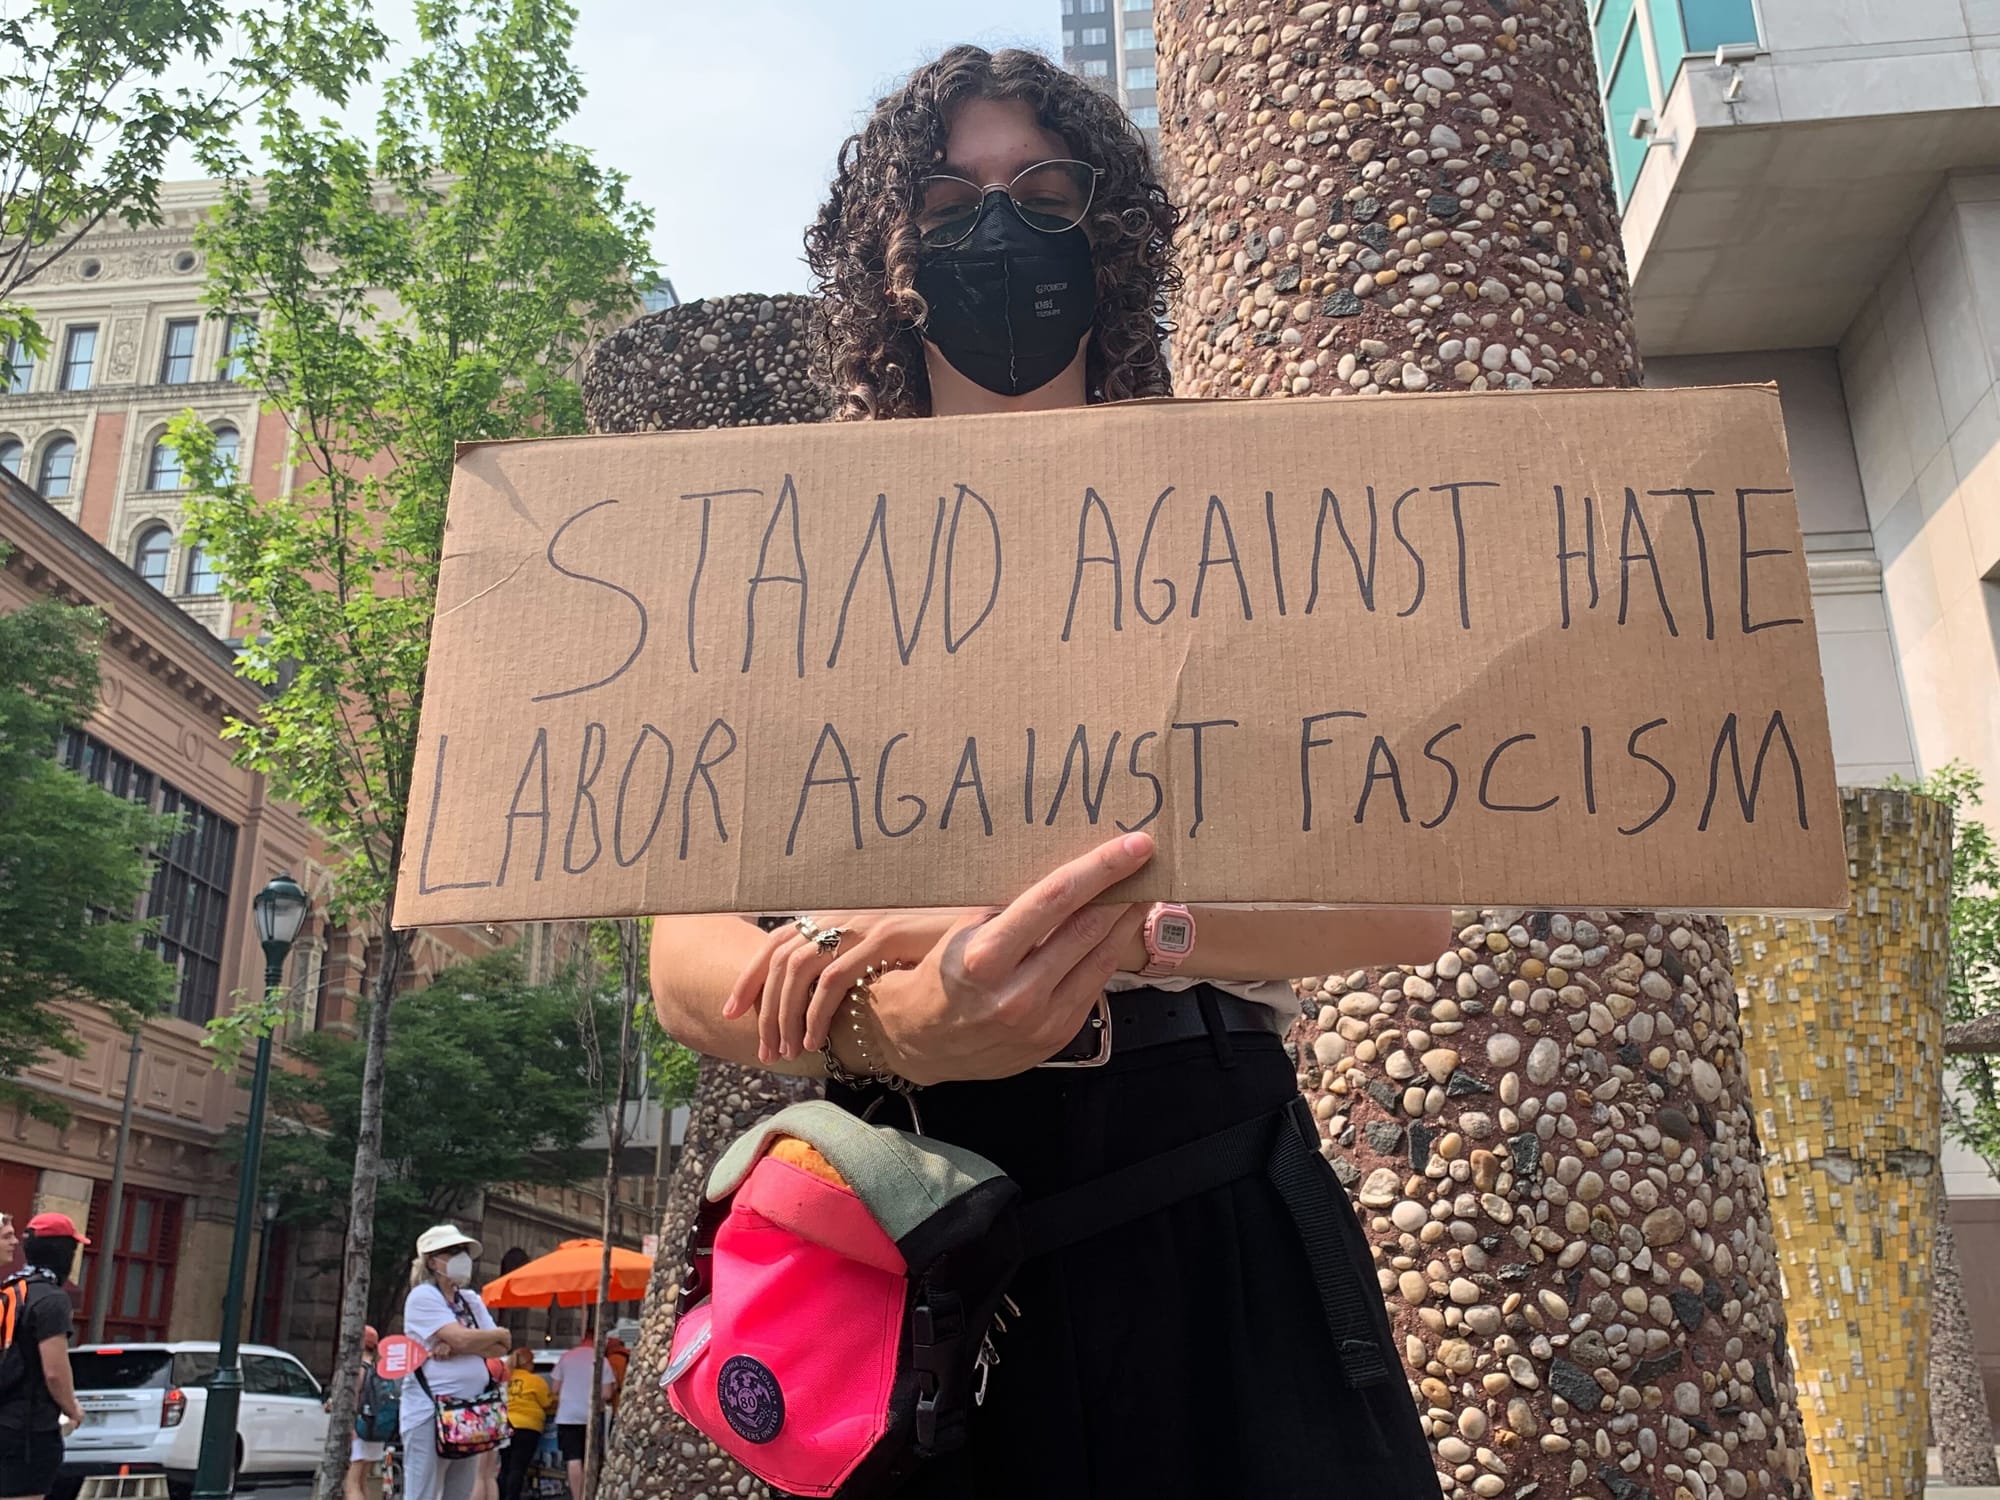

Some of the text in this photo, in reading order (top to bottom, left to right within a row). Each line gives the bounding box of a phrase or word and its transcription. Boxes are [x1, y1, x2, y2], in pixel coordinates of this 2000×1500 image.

[531, 473, 1804, 702] STAND AGAINST HATE
[419, 710, 1809, 895] LABOR AGAINST FASCISM
[719, 1359, 776, 1401] PHILADELPHIA JOINT BOARD
[740, 1396, 756, 1409] 80
[727, 1411, 778, 1441] WORKERS UNITED
